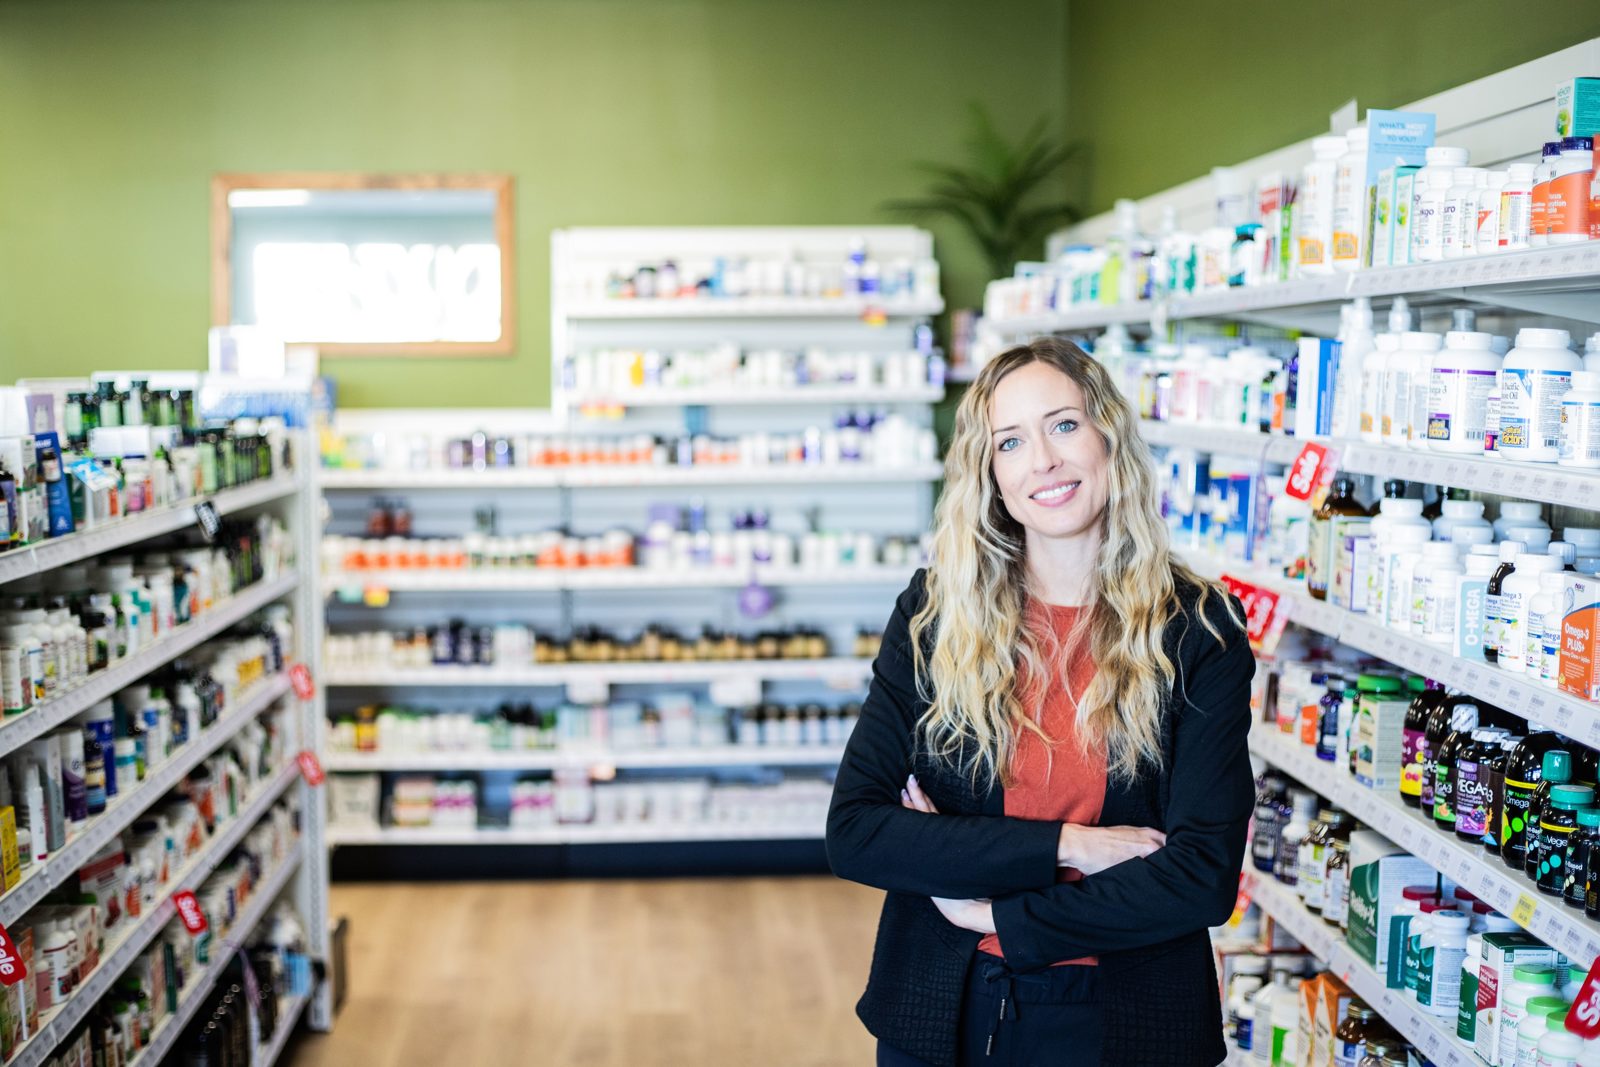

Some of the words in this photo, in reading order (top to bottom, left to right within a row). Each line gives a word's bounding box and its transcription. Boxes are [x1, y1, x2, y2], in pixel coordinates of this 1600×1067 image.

[1291, 450, 1320, 494] Sale
[1465, 588, 1481, 646] O-MEGA
[1564, 622, 1590, 640] Omega-3
[1567, 637, 1585, 652] PLUS+
[1506, 795, 1530, 809] Omega
[177, 896, 202, 930] Sale
